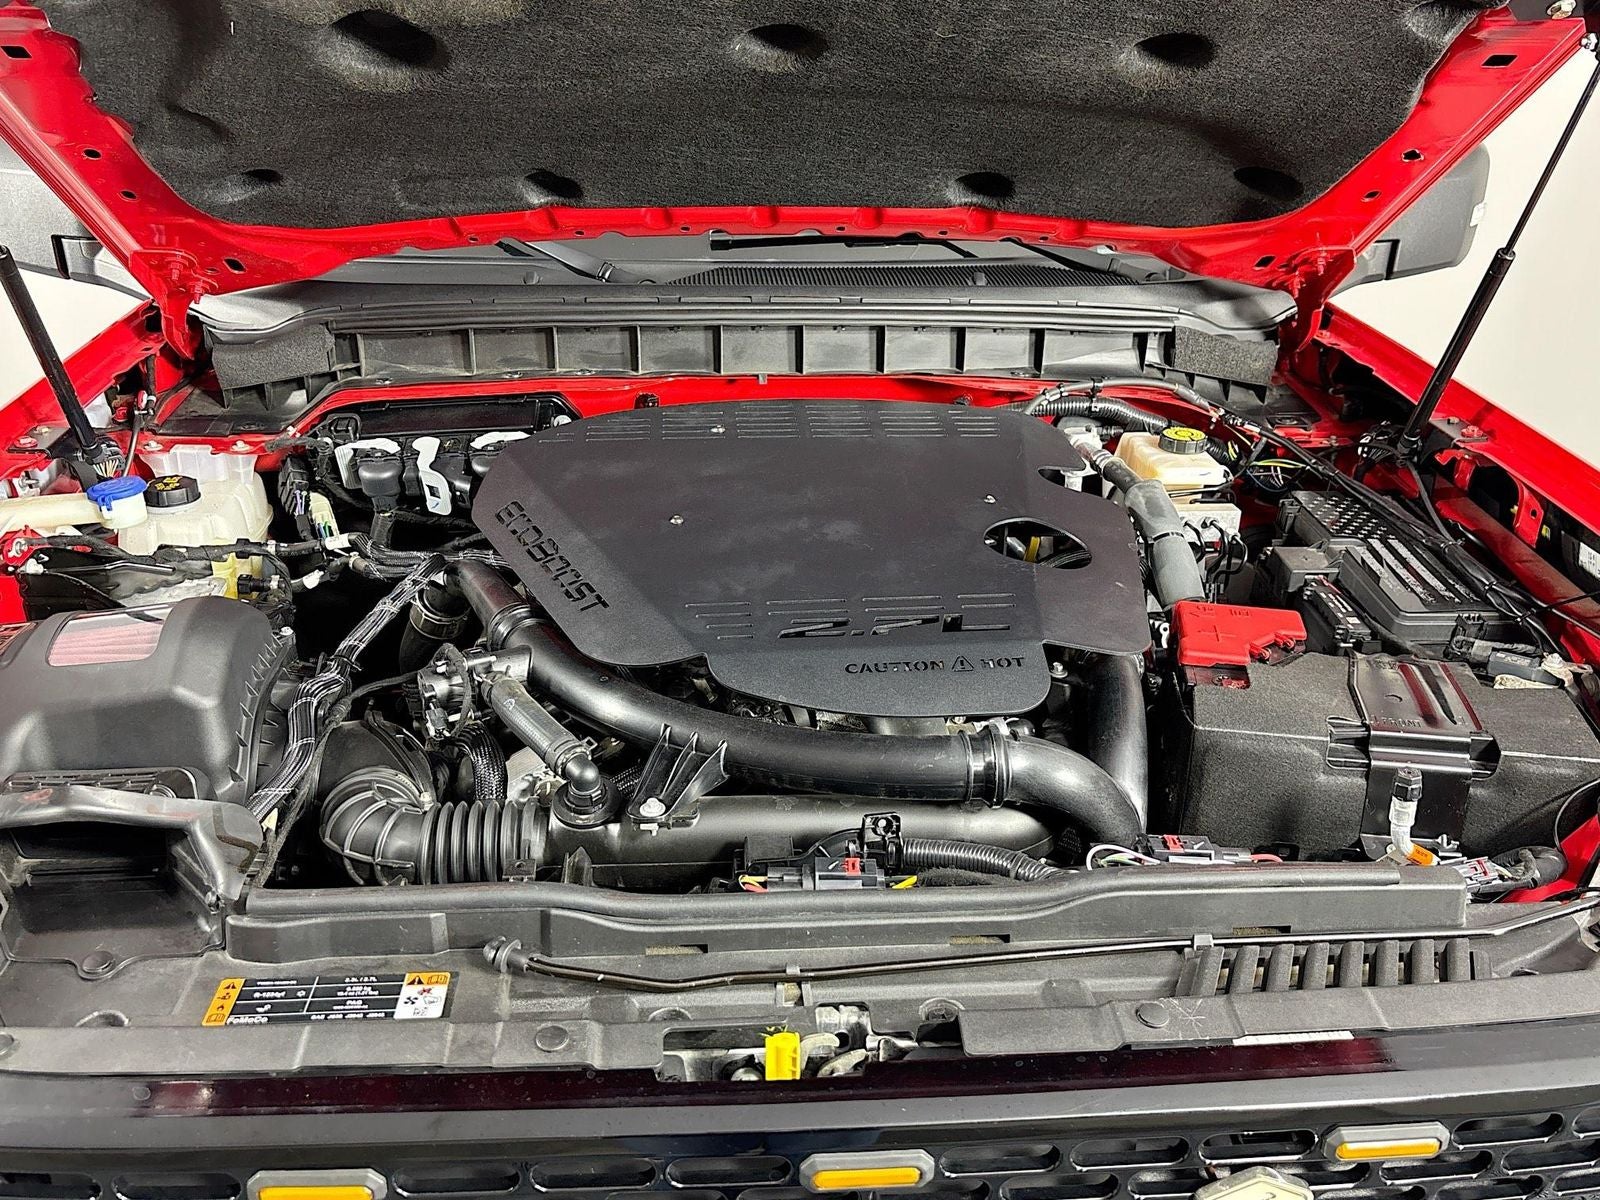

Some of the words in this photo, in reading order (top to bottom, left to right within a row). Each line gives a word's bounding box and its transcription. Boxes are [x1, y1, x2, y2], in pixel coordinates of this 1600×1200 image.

[495, 500, 609, 612] ECOBOOST
[777, 613, 1011, 639] 2.7L
[844, 660, 945, 674] CAUTION
[980, 656, 1025, 669] HOT
